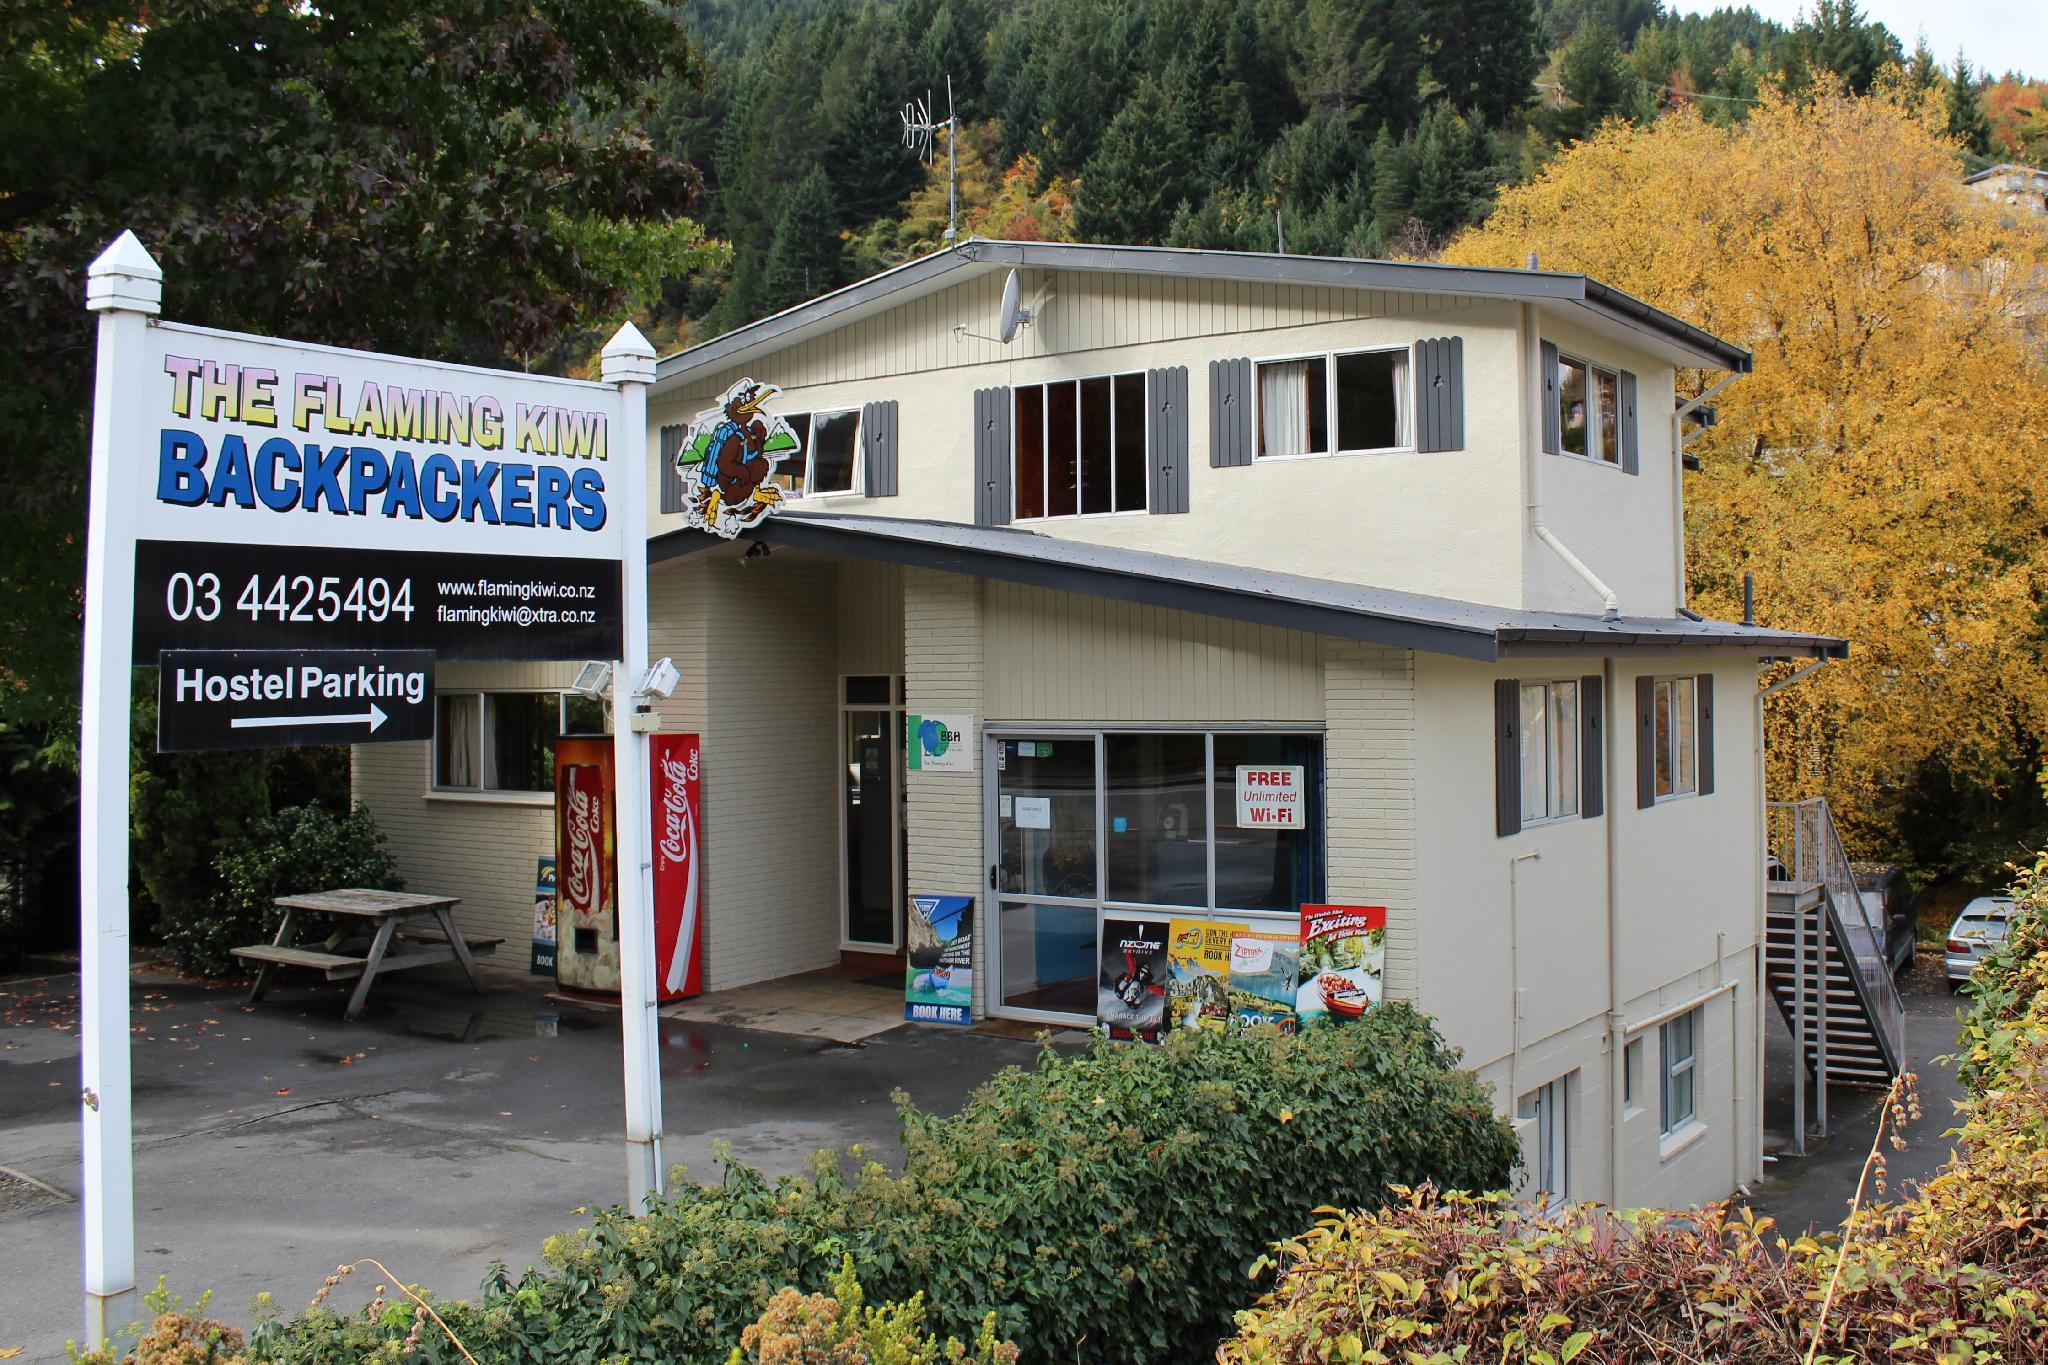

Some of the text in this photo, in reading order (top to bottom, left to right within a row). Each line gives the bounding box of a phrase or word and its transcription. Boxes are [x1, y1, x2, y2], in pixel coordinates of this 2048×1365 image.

[164, 354, 608, 461] THE FLAMING KIWI
[157, 429, 607, 531] BACKPACKERS
[167, 572, 415, 622] 03 4425494
[437, 579, 596, 601] www.flamingkiwi.co.nz
[437, 604, 596, 627] flamingkiwi@xtra.co.nz
[176, 665, 425, 705] Hostel Parking
[941, 731, 961, 742] BBH
[687, 749, 698, 781] Coke
[1247, 771, 1292, 786] FREE
[1243, 790, 1297, 803] Unlimited
[590, 796, 600, 834] Coke
[1250, 807, 1292, 823] Wi-Fi
[1306, 913, 1367, 940] Exciting
[1204, 949, 1222, 960] BOOK
[912, 1005, 963, 1021] BOOK HERE
